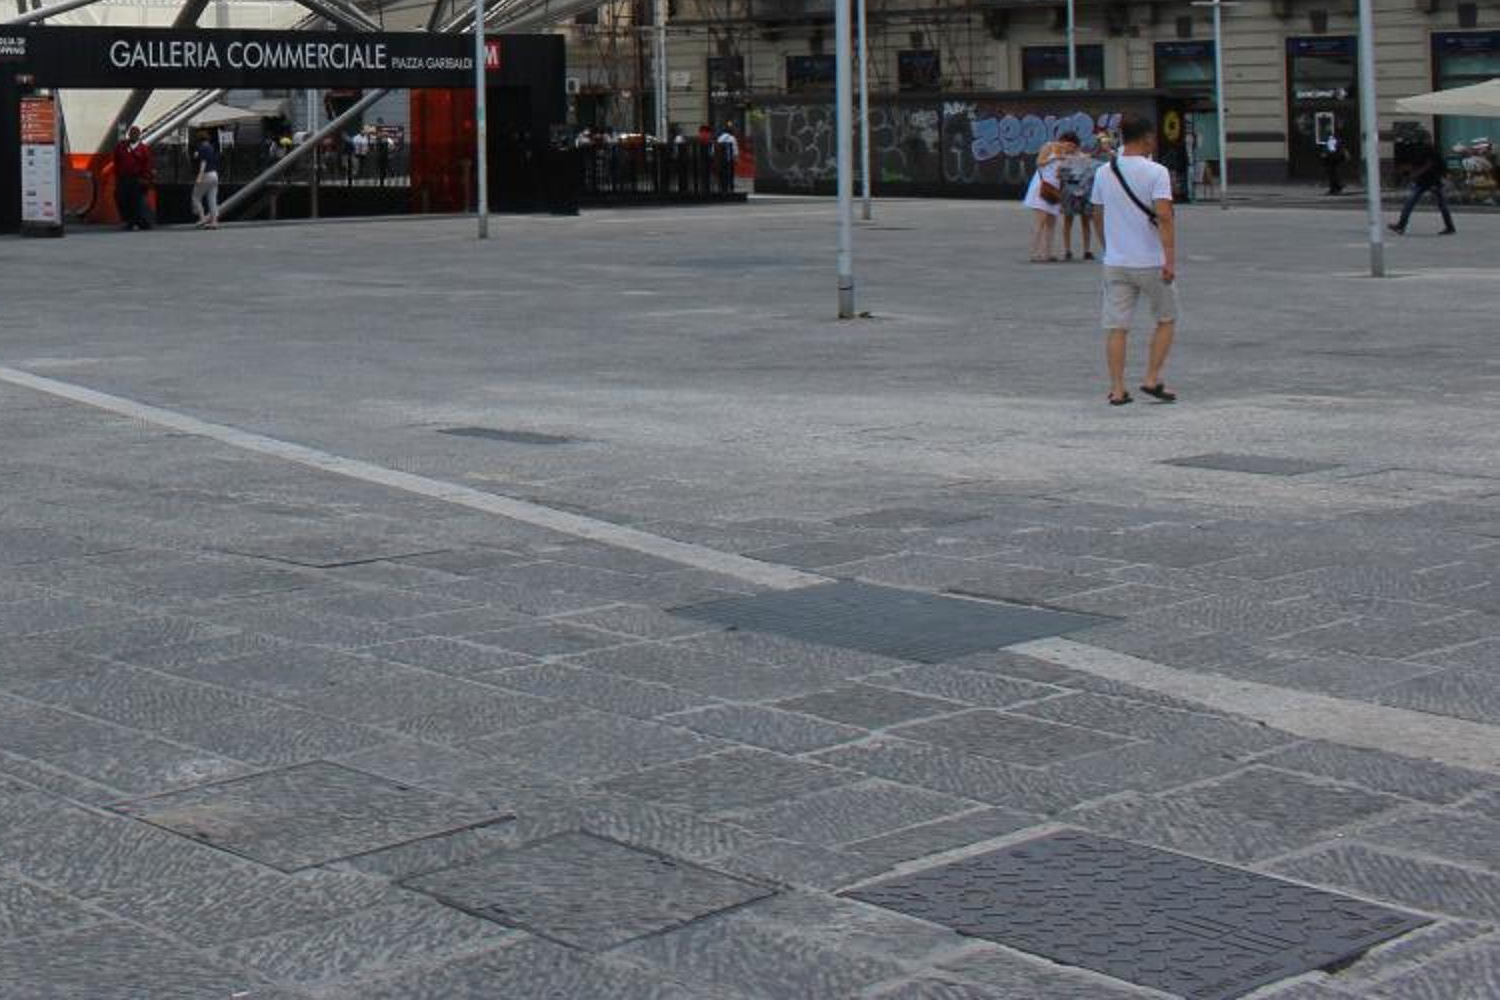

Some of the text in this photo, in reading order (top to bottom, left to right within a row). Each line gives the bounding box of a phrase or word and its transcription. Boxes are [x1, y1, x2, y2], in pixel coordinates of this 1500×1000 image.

[109, 40, 473, 69] GALLERIA COMMERCIALE PIAZZA GARIBALDI
